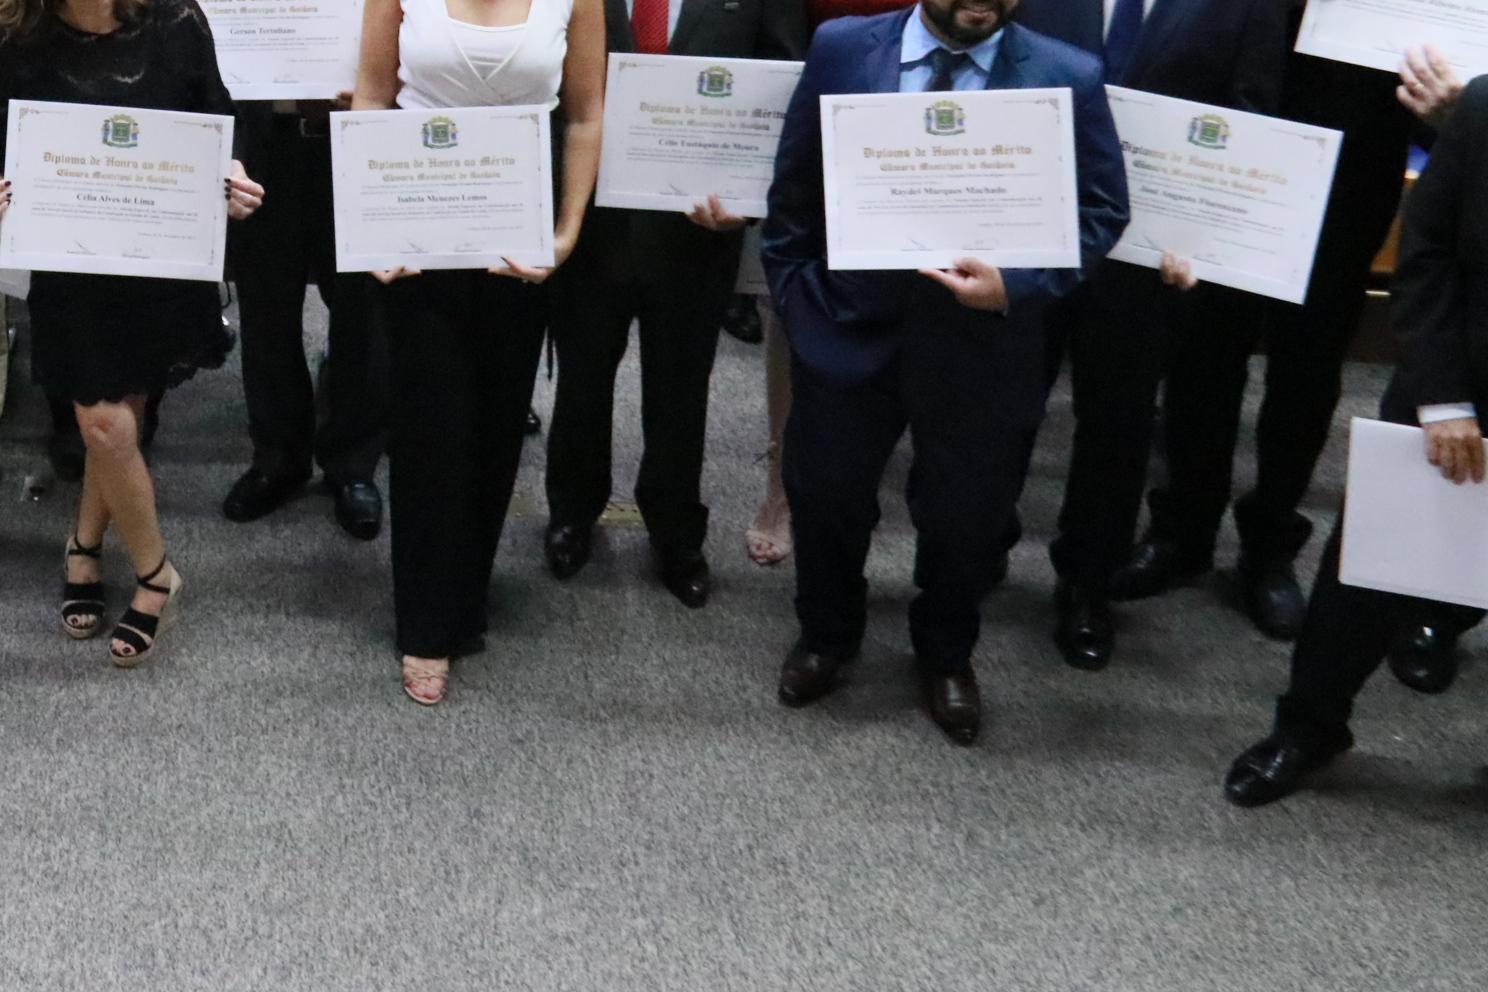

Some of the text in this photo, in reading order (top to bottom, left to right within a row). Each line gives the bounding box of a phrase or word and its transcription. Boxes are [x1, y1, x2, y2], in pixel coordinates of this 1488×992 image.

[863, 144, 1032, 159] Diploma de Honra ao Mérito
[43, 151, 195, 173] Diploma de Honra ao Mérito
[368, 155, 515, 170] Diploma de Honra ao Mérito
[57, 168, 89, 178] Câmara
[93, 171, 132, 182] Municipal
[135, 174, 144, 182] de
[924, 187, 962, 196] Marques
[76, 193, 155, 205] Célia Alves de Lima
